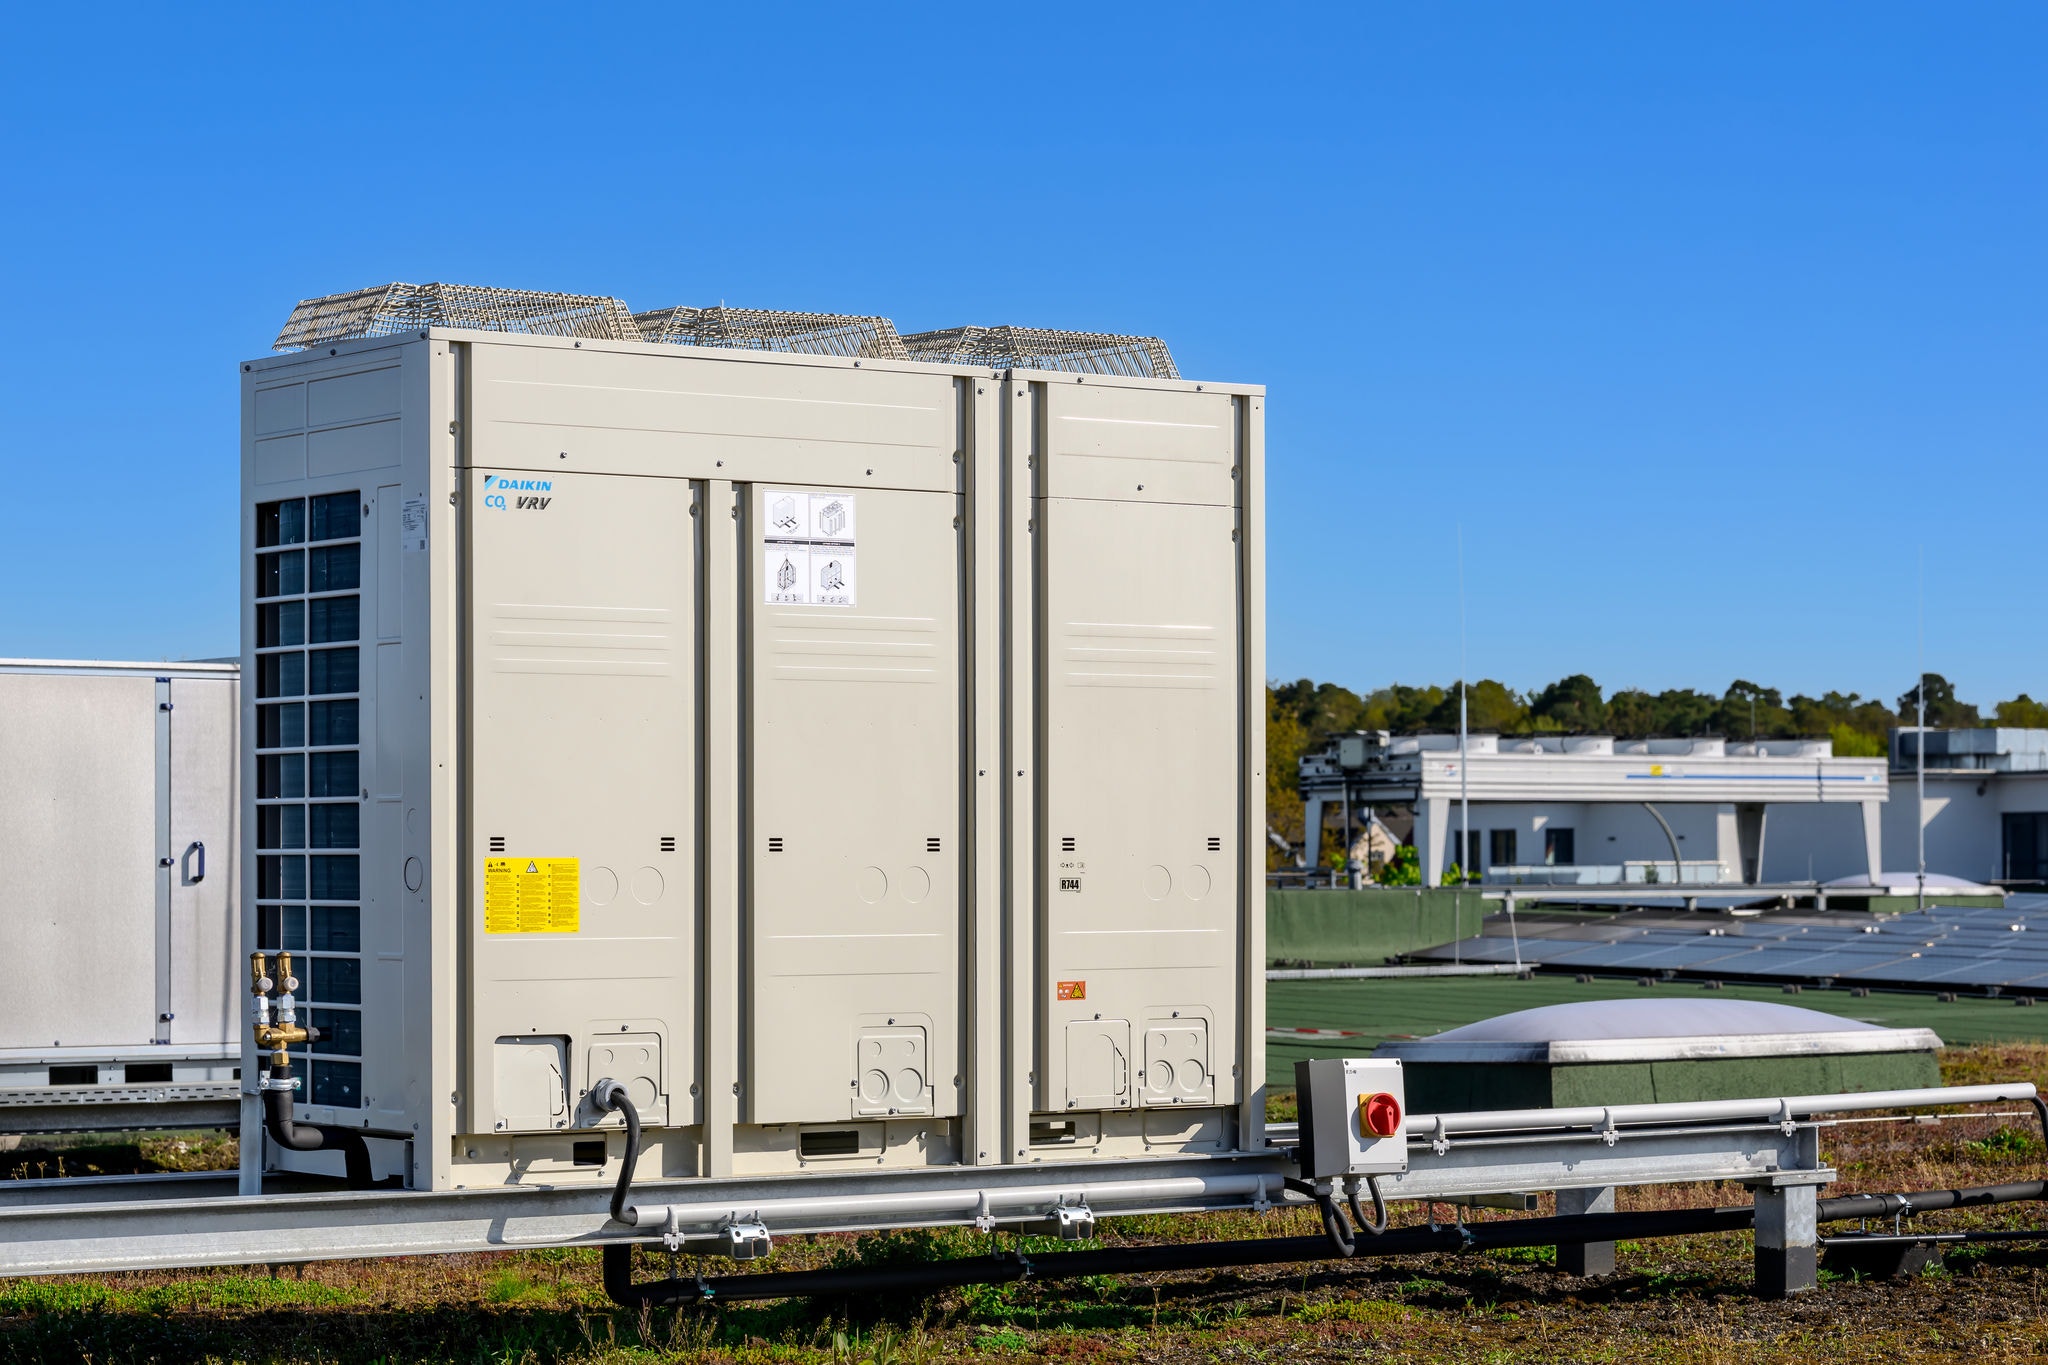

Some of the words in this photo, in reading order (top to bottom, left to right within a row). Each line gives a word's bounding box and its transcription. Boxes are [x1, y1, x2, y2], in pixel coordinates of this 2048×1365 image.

[498, 479, 552, 491] DAIKIN
[516, 496, 552, 510] VRV
[1061, 879, 1079, 890] R744
